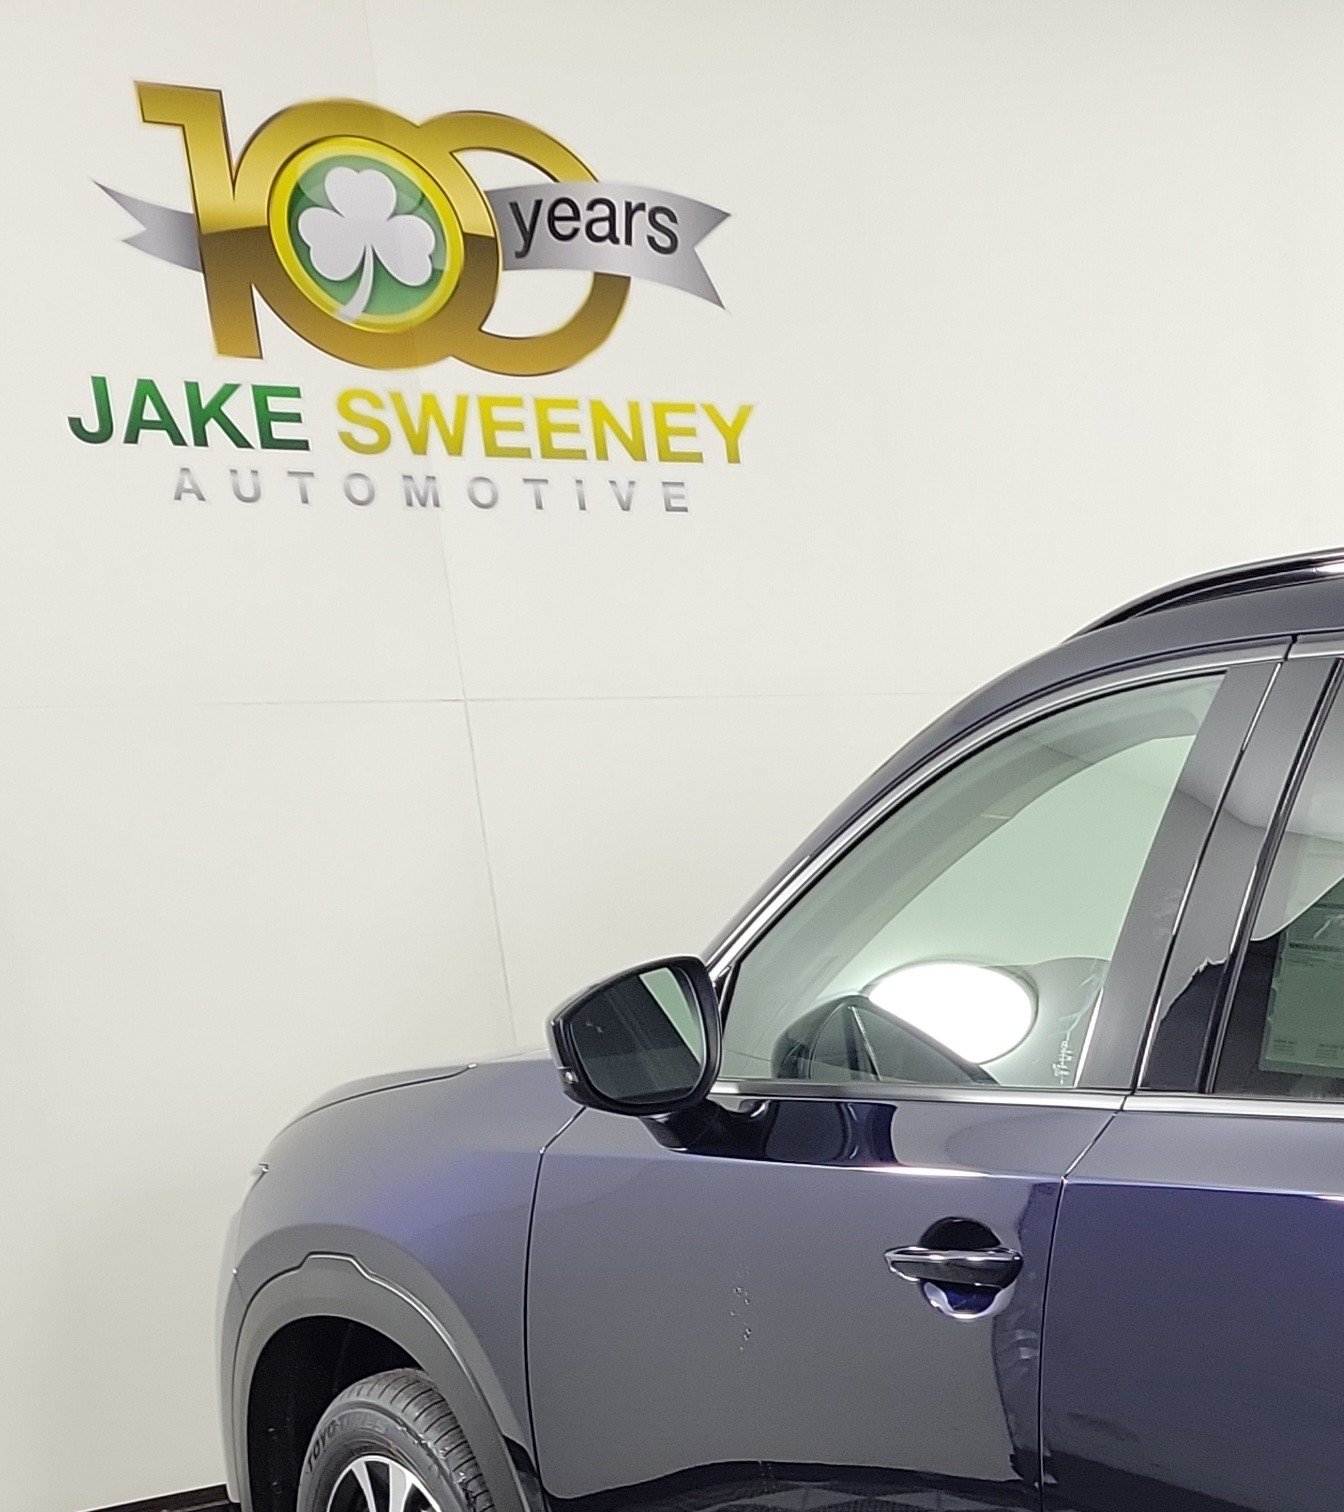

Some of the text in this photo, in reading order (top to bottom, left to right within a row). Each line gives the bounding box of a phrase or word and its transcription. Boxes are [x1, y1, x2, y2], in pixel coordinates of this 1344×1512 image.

[133, 79, 680, 377] 100 years
[67, 375, 755, 464] JAKE SWEENEY
[173, 466, 690, 513] AUTOMOTIVE
